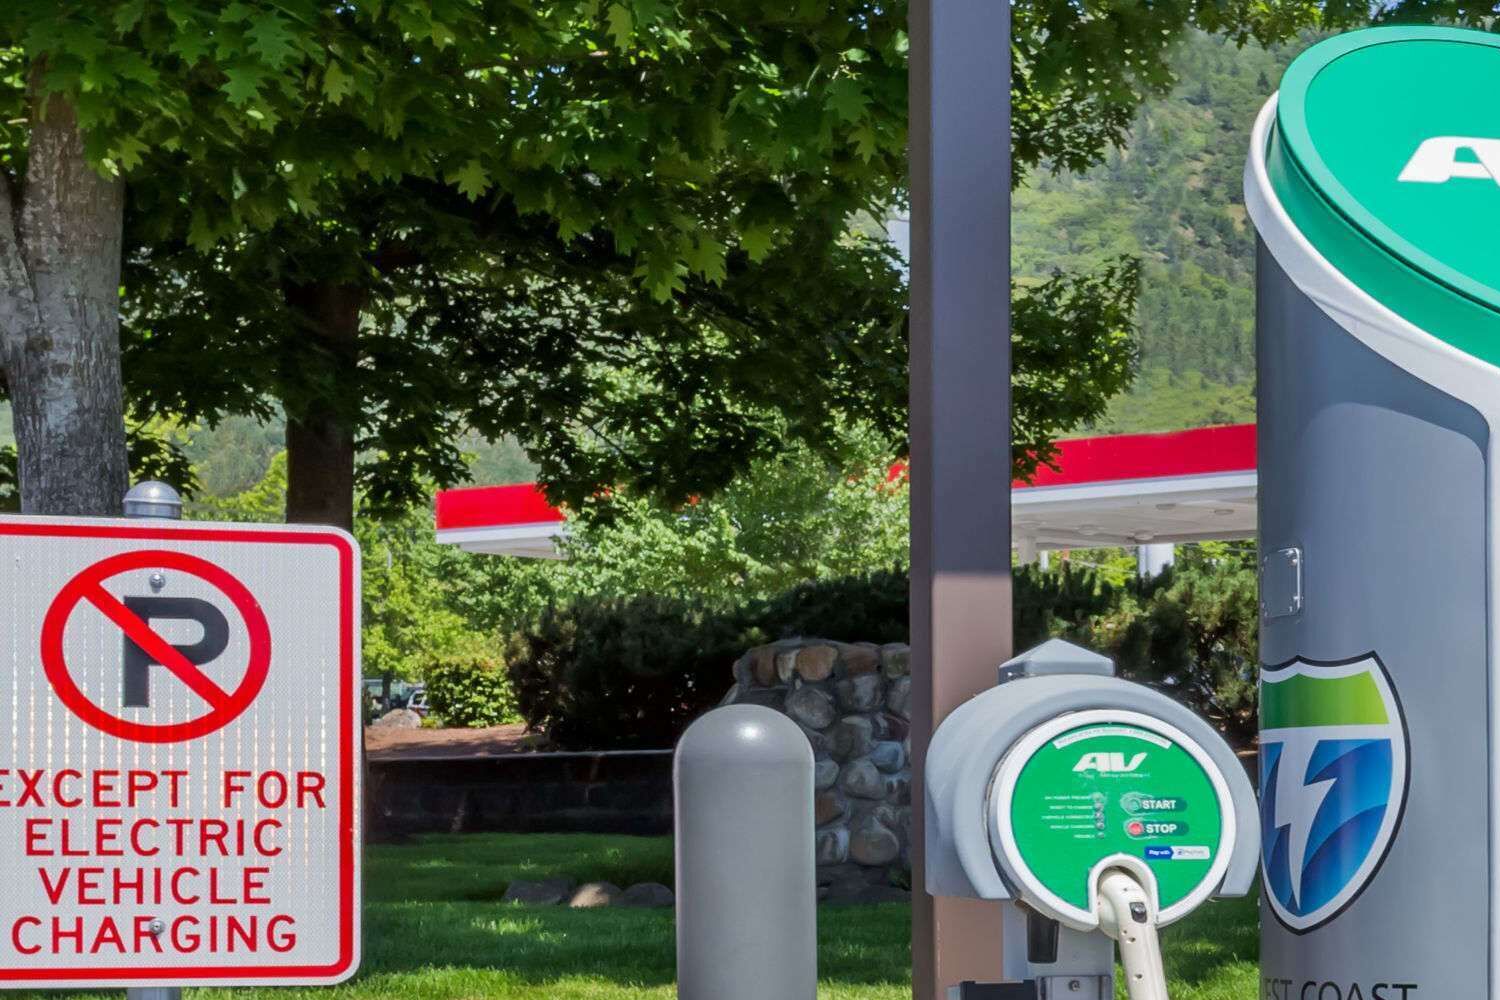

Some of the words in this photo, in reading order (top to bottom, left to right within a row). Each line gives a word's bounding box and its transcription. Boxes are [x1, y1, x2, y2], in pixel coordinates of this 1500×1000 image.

[224, 771, 327, 809] FOR
[1142, 799, 1177, 810] START
[25, 818, 283, 857] ELECTRIC
[1146, 823, 1177, 834] STOP
[38, 867, 271, 905] VEHICLE
[11, 915, 297, 955] CHARGING
